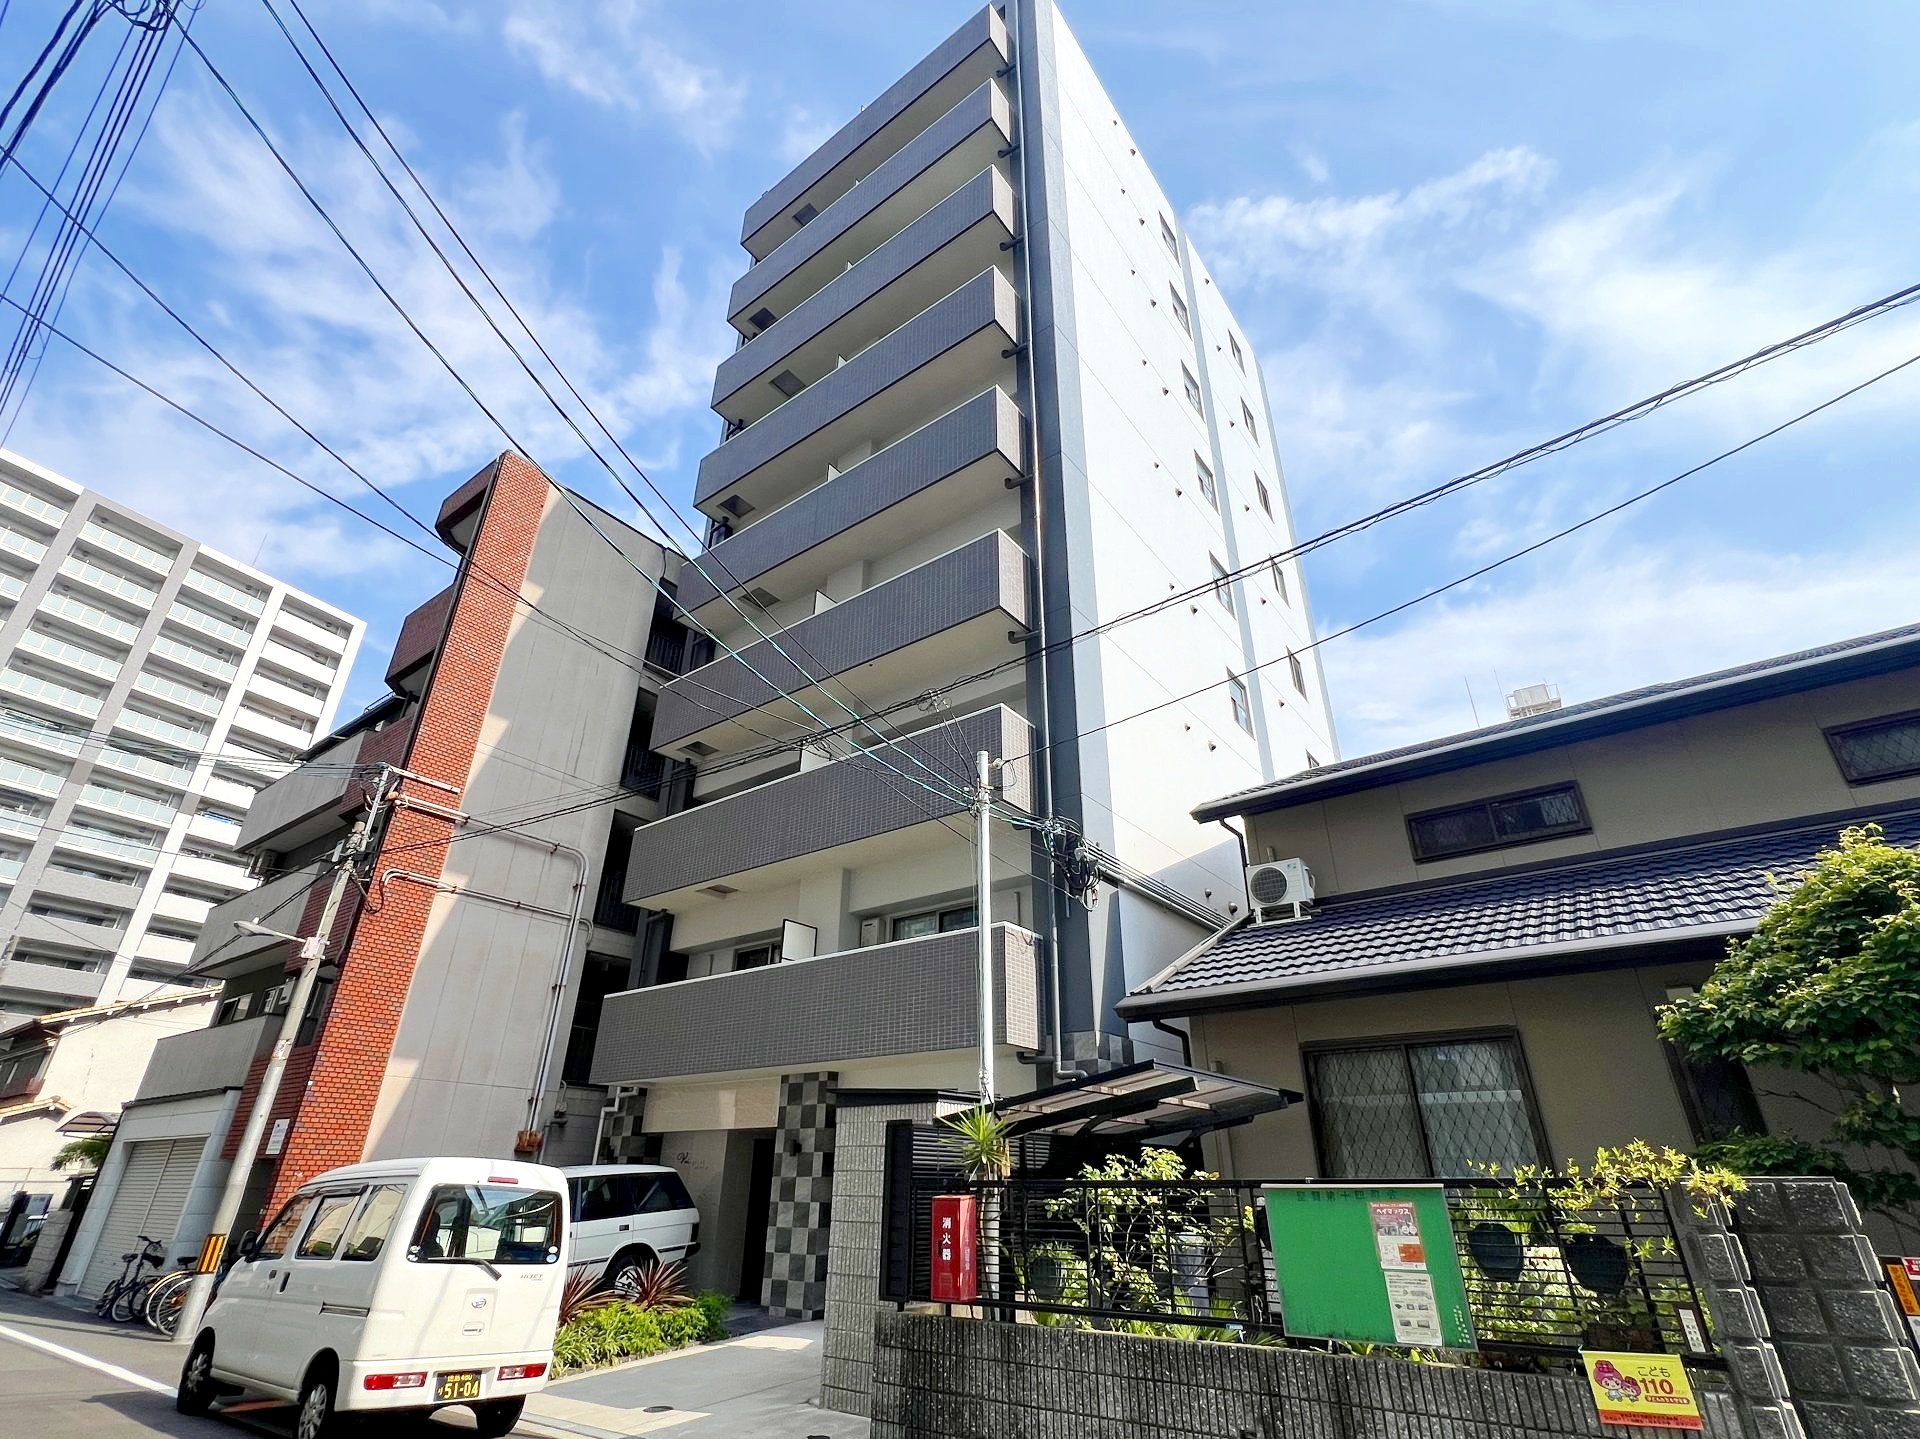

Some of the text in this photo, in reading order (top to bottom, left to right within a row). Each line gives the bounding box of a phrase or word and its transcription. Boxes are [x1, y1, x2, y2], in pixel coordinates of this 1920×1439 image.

[942, 1217, 952, 1261] 消火器
[1637, 1366, 1671, 1378] こども
[443, 1381, 479, 1399] 51-04
[1638, 1377, 1674, 1395] 110
